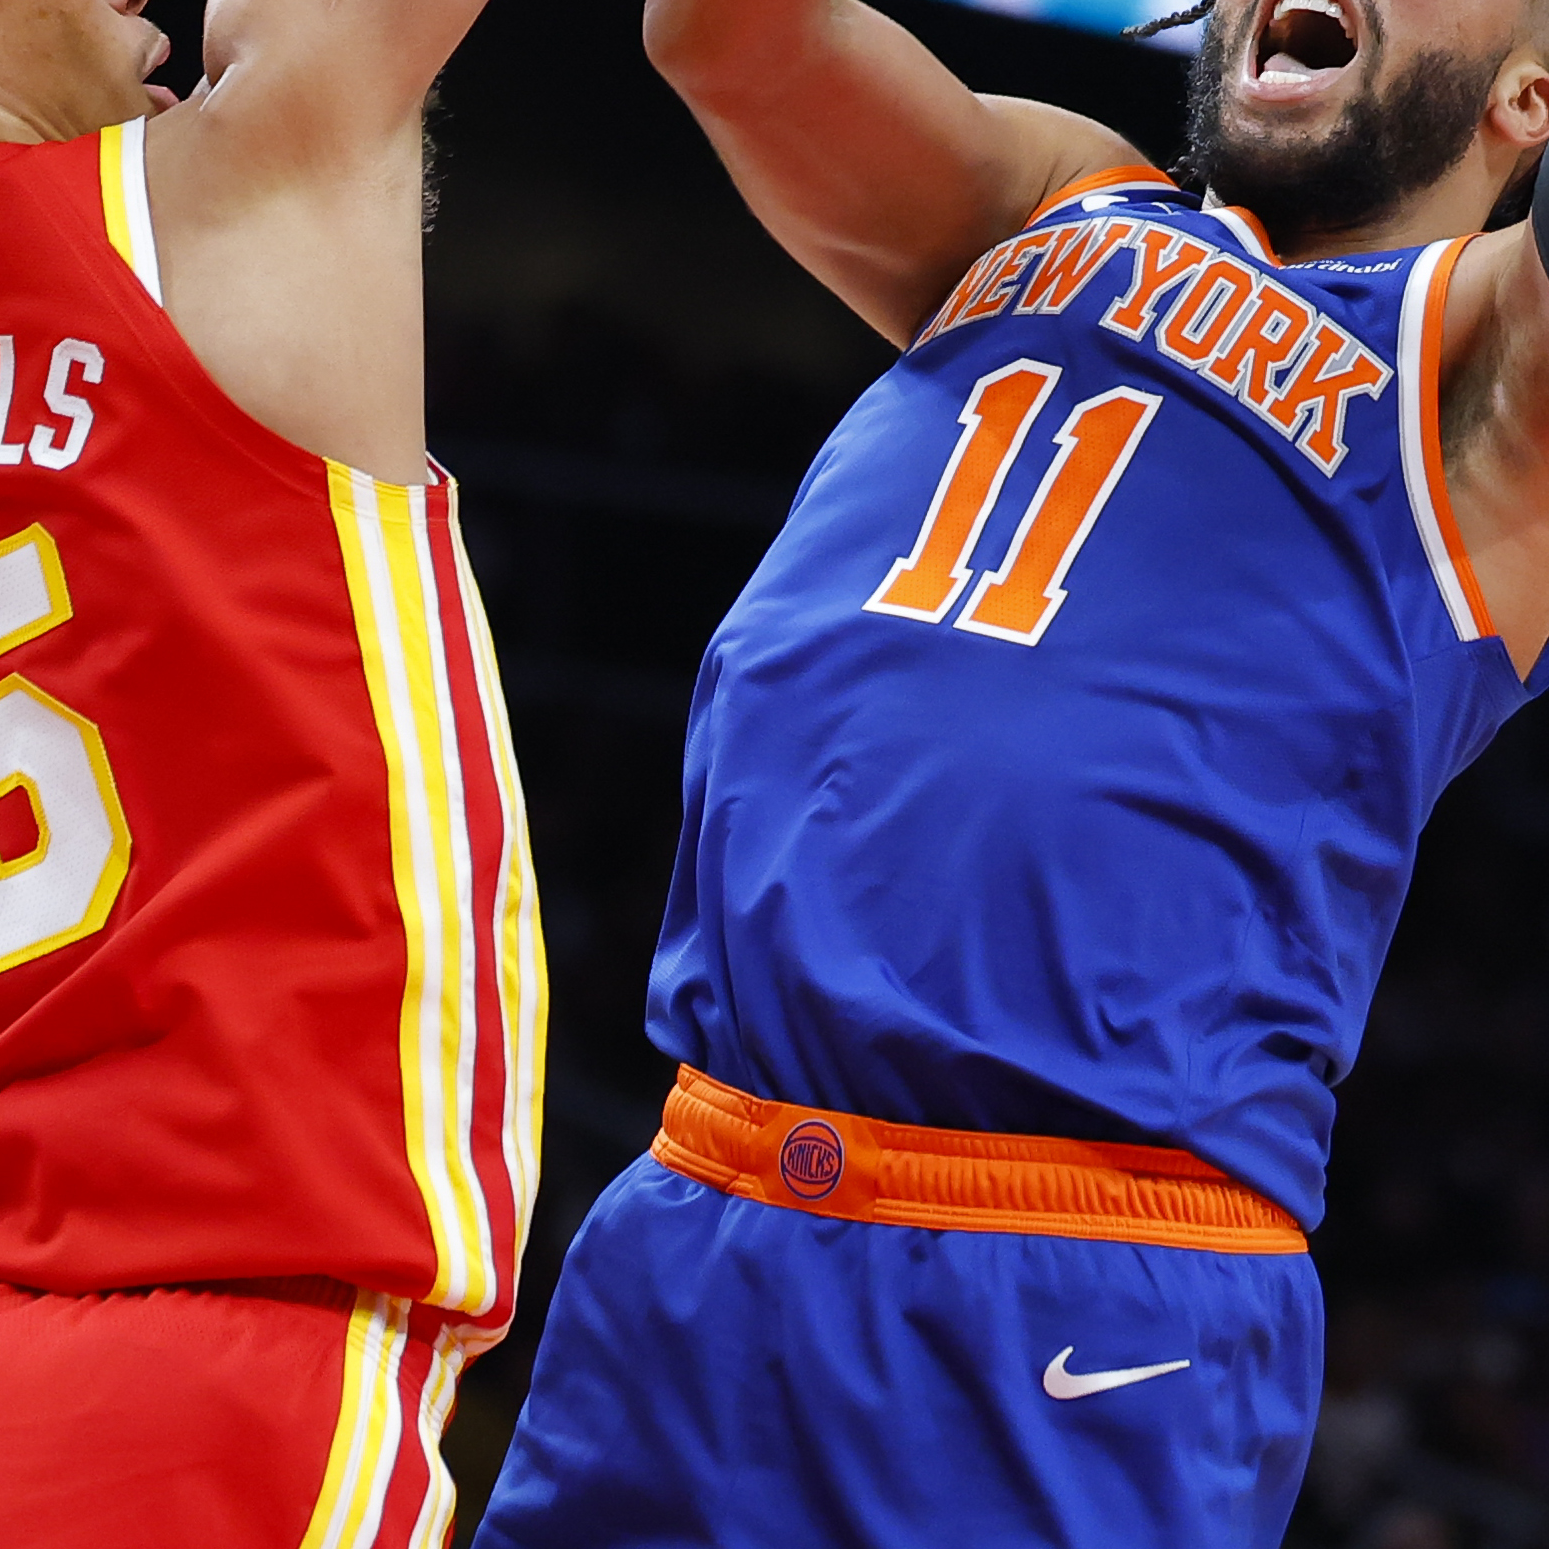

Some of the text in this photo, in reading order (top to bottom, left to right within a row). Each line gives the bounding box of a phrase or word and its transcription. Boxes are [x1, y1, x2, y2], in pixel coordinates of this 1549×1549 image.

[905, 217, 1395, 479] NEW YORK
[861, 358, 1163, 646] 11
[788, 1143, 835, 1179] KNICKS
